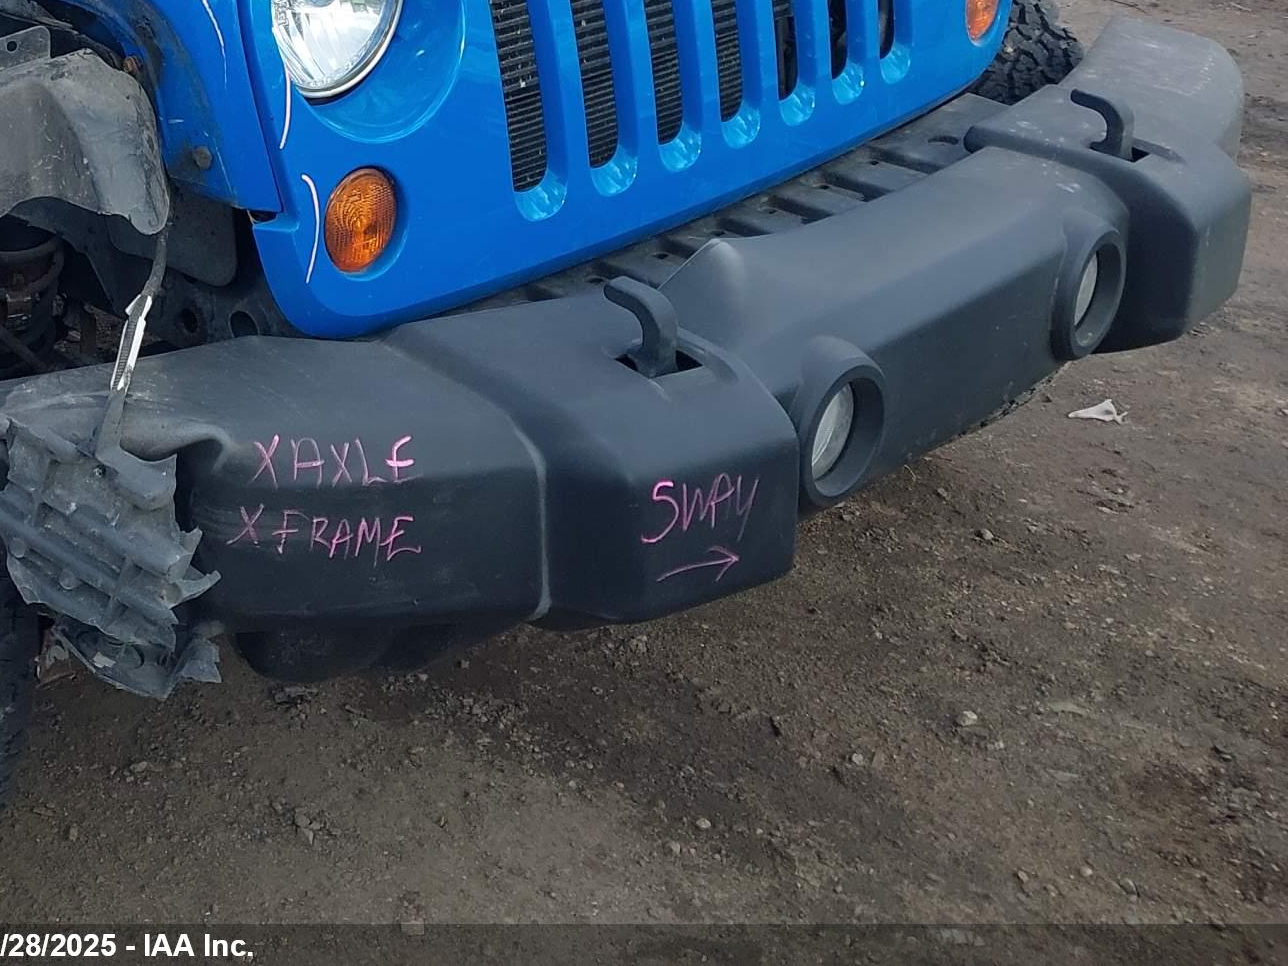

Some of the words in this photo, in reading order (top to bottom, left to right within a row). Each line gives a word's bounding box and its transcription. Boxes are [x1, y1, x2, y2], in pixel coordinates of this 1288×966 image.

[227, 504, 264, 545] X
[272, 509, 421, 566] FRAME
[641, 472, 760, 543] SWAY
